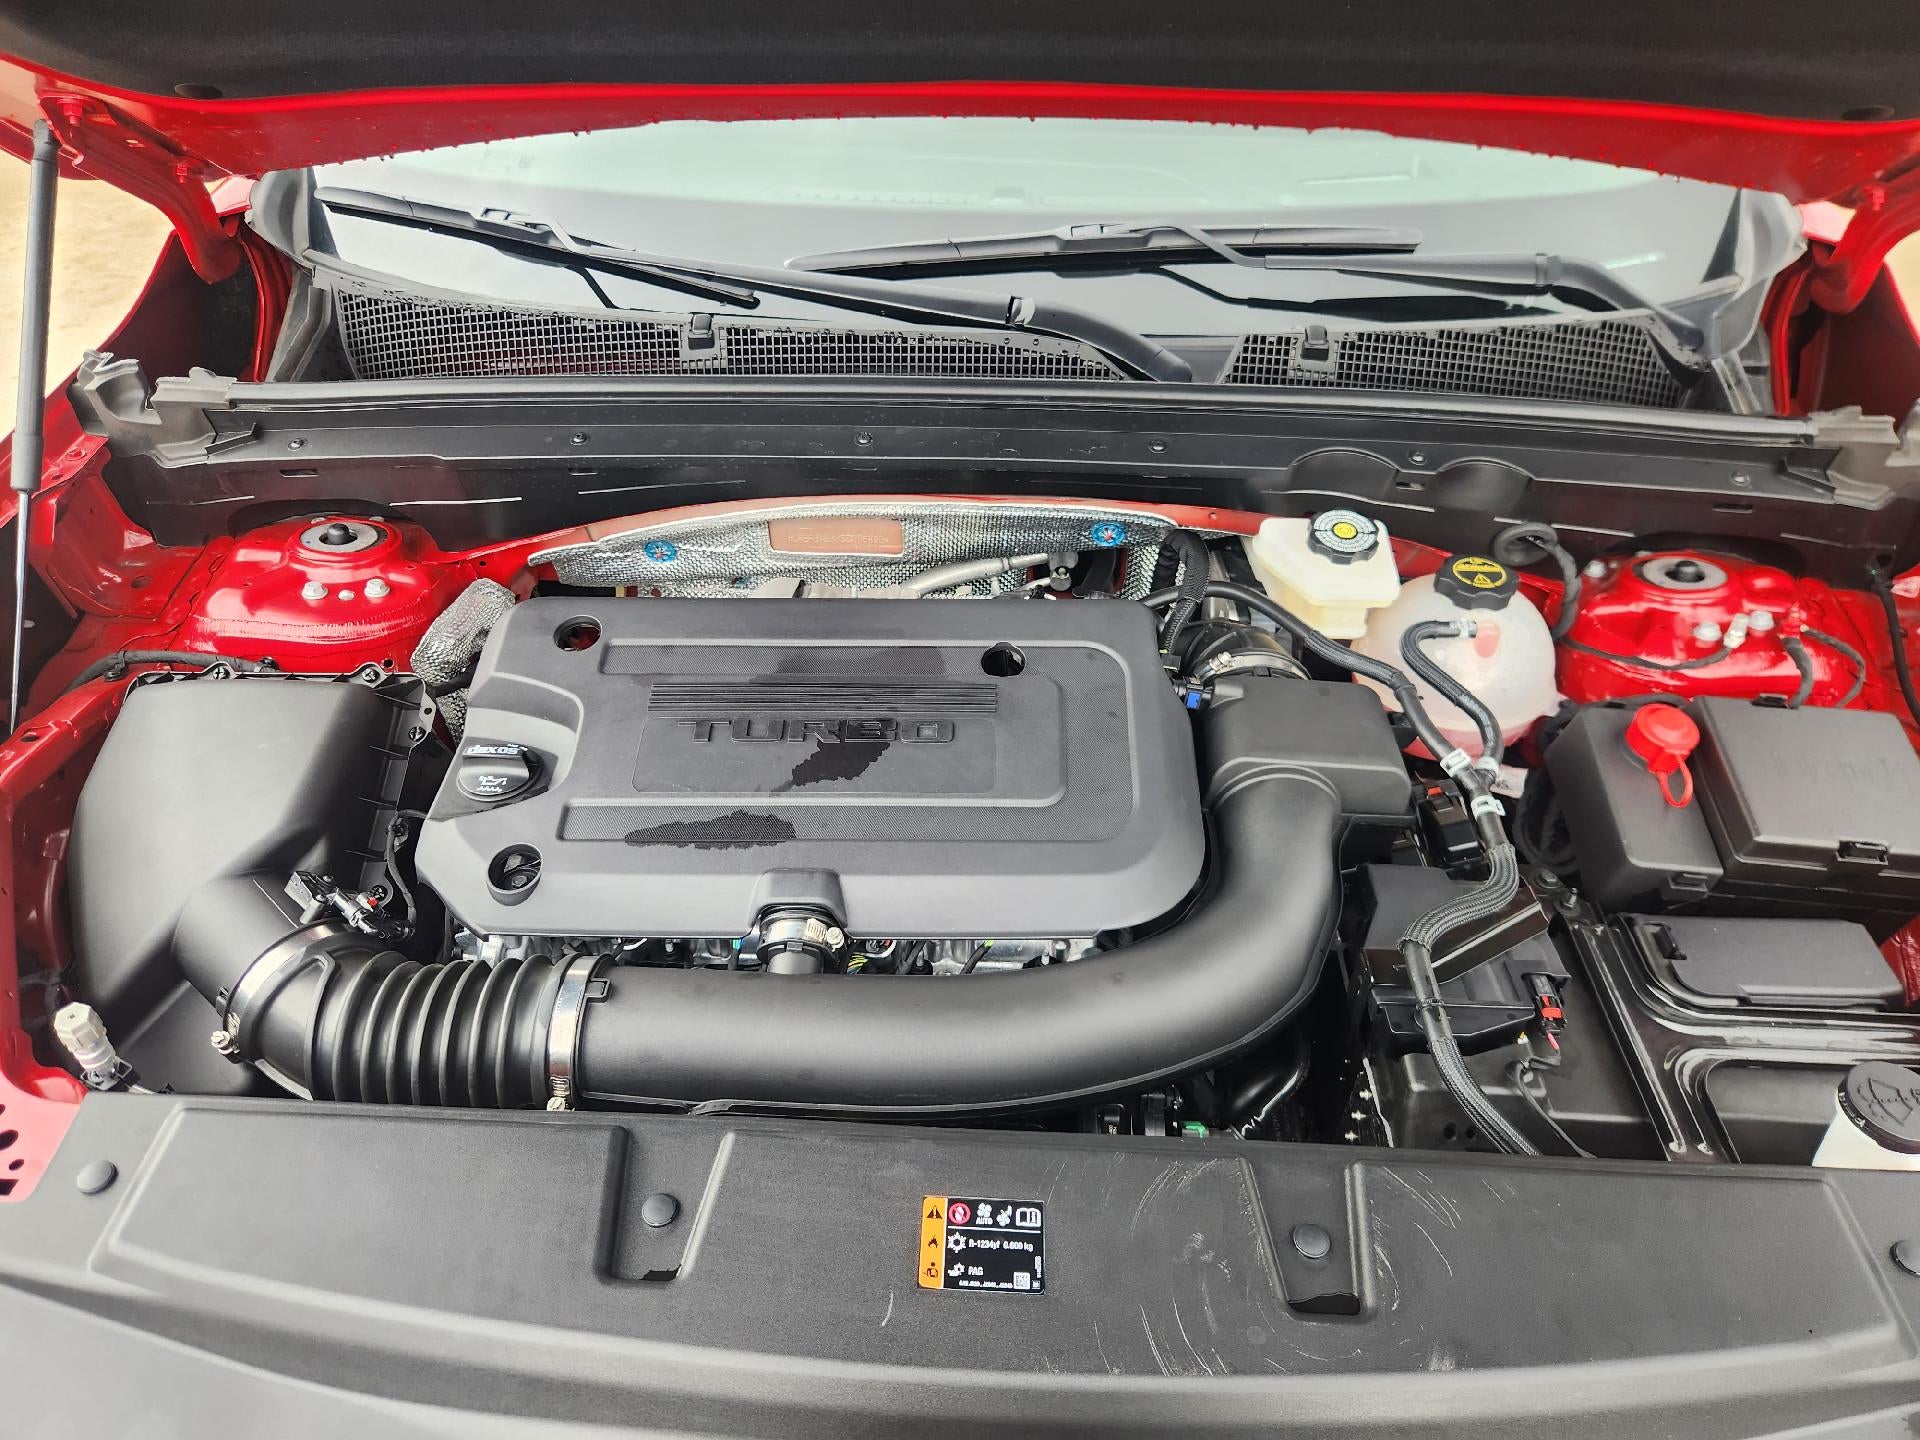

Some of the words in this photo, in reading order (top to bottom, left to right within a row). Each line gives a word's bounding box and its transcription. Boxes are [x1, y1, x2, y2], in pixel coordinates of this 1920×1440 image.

[678, 719, 954, 743] TURBO
[976, 1217, 993, 1225] AUTO
[969, 1239, 1000, 1250] R-1234yf
[1024, 1242, 1034, 1252] kg
[968, 1266, 983, 1276] PAG
